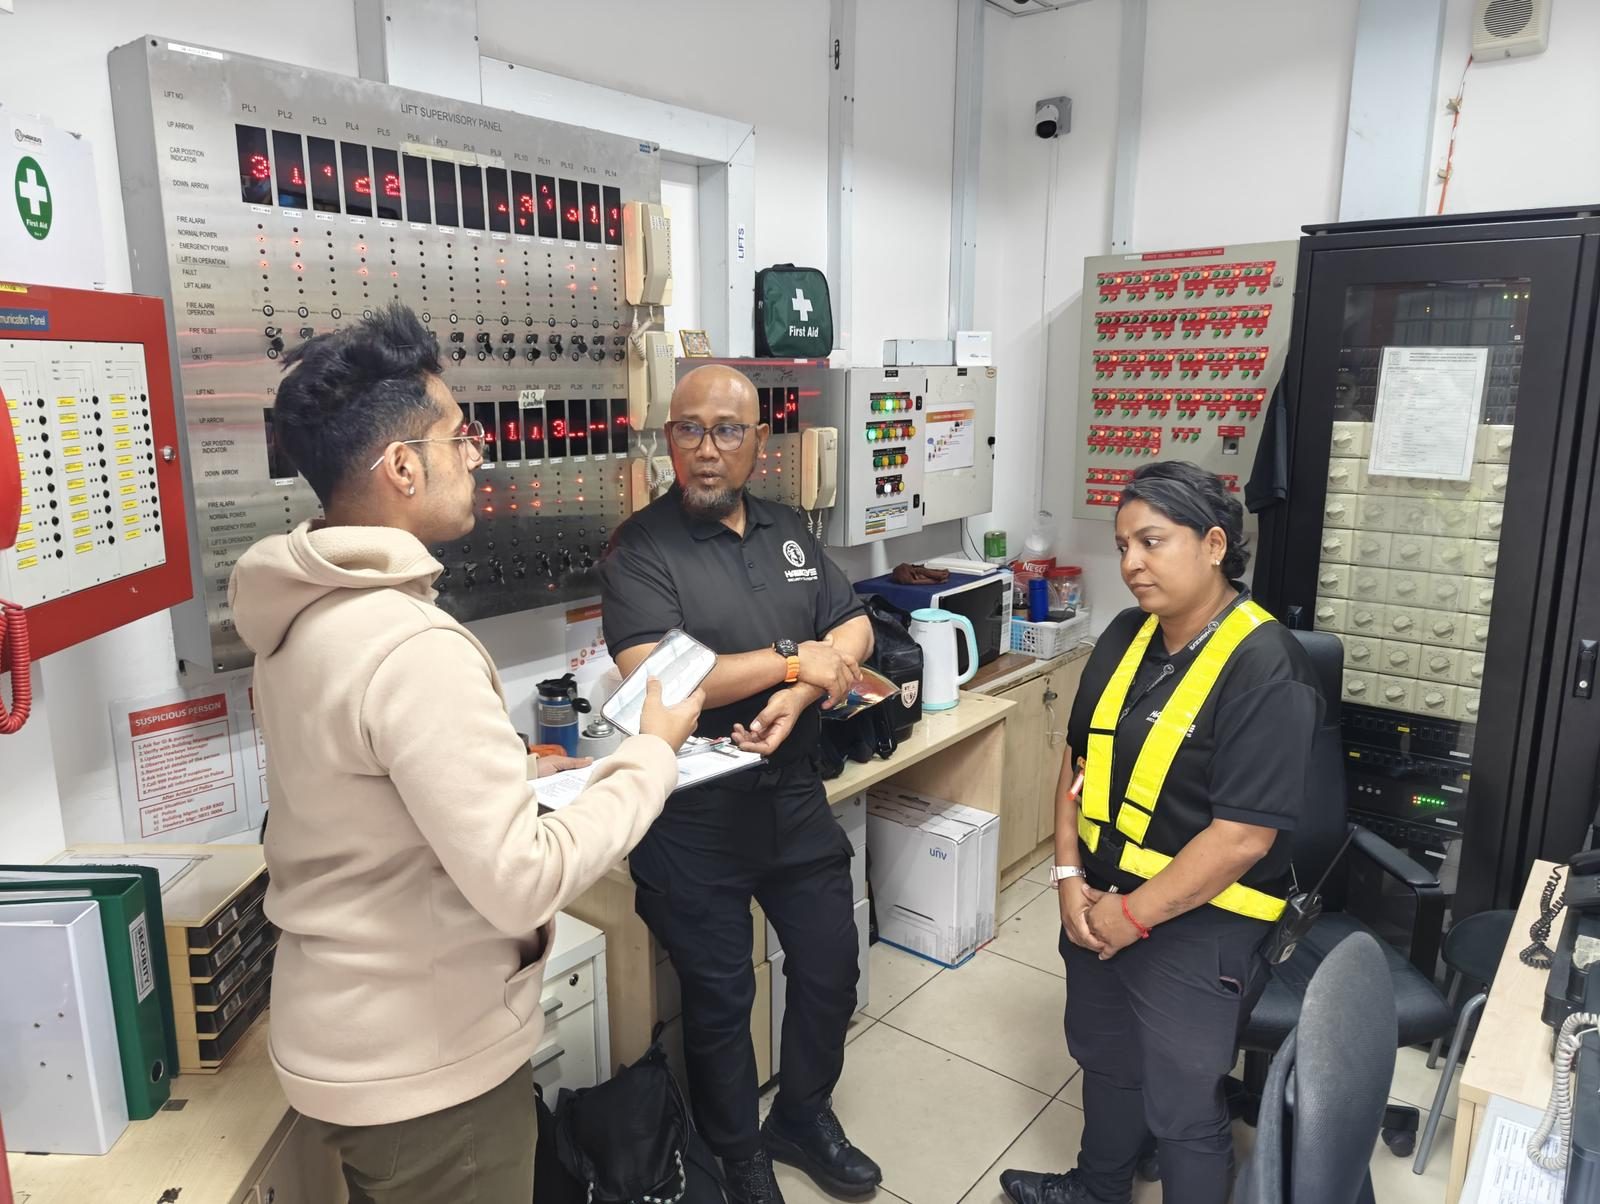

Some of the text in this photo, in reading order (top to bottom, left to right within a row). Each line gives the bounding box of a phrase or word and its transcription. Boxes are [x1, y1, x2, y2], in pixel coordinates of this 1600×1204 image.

[401, 103, 502, 132] LIFT SUPERVISORY PANEL
[174, 121, 194, 131] ARROW
[242, 103, 257, 113] PL1
[278, 110, 293, 120] PL2
[312, 116, 327, 126] PL3
[346, 122, 360, 131] PL4
[377, 128, 391, 137] PL5
[436, 138, 448, 147] PL7
[604, 169, 618, 178] PL14
[170, 146, 204, 158] CAR POSITION
[170, 154, 197, 164] INDICATOR
[172, 180, 209, 190] DOWN ARROW
[176, 216, 206, 225] FIRE ALARM
[178, 229, 218, 239] NORMAL POWER
[180, 242, 229, 252] EMERGENCY POWER
[181, 256, 192, 264] LIFT
[198, 258, 226, 266] OPERATION
[182, 268, 198, 276] FAULT
[194, 282, 212, 290] ALARM
[198, 302, 215, 310] ALARM
[186, 308, 215, 316] OPERATION
[789, 325, 819, 338] First Aid
[192, 346, 202, 354] LIFT
[477, 384, 492, 392] PL22
[202, 446, 228, 454] INDICATOR
[204, 470, 220, 478] DOWN
[210, 524, 240, 532] EMERGENCY
[930, 847, 948, 861] unv
[139, 927, 150, 983] SECURITY
